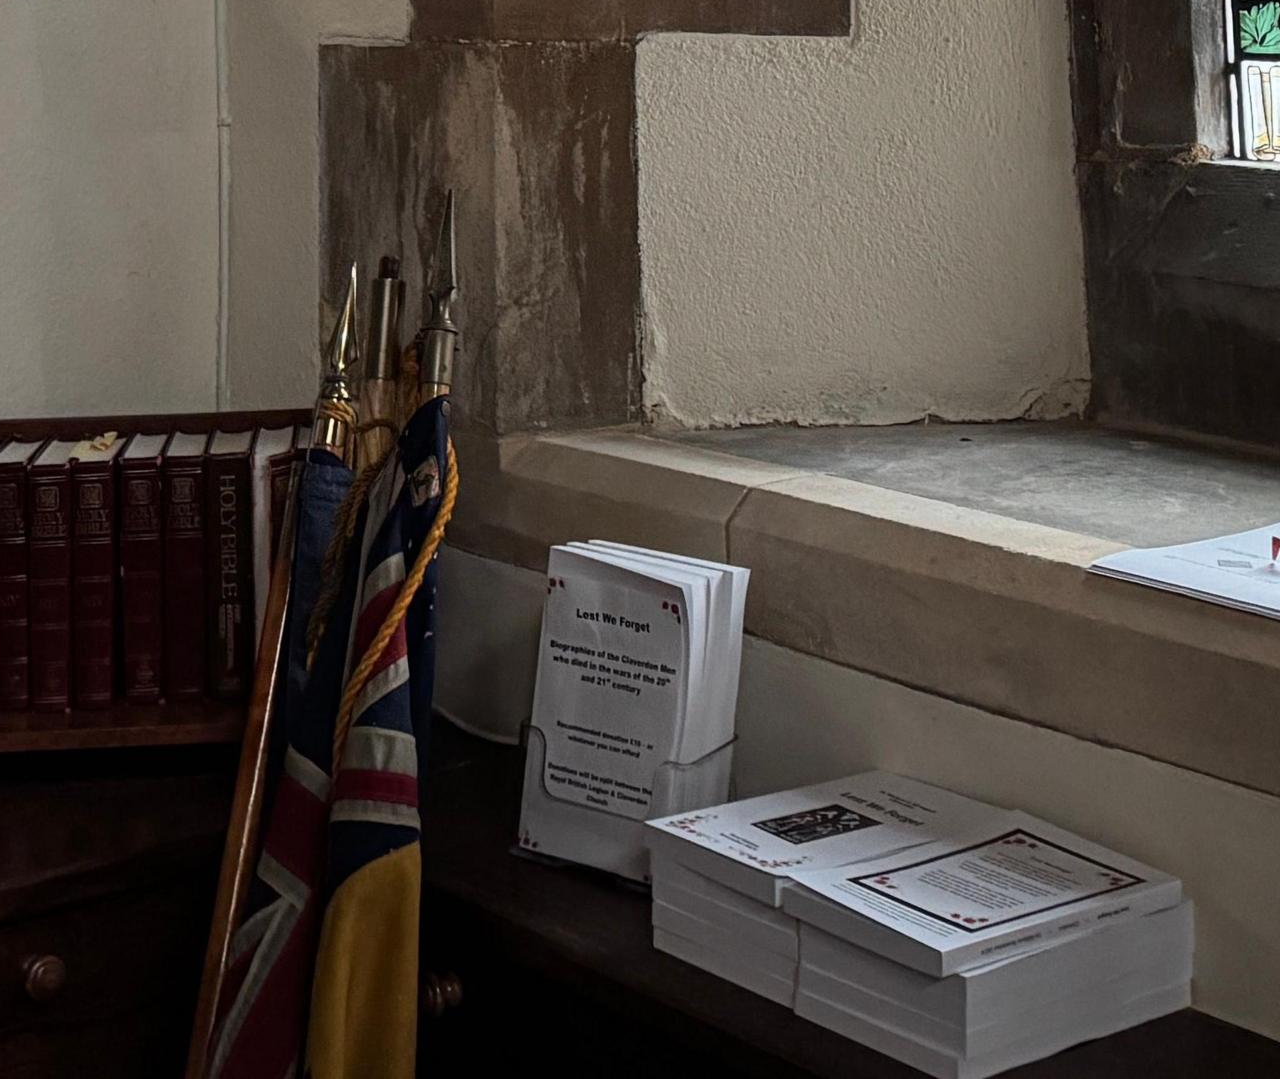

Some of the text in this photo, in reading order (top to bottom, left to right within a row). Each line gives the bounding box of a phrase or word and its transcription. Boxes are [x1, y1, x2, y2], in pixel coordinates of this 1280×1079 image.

[219, 475, 236, 525] HOLY
[577, 608, 650, 632] Lest We Forget
